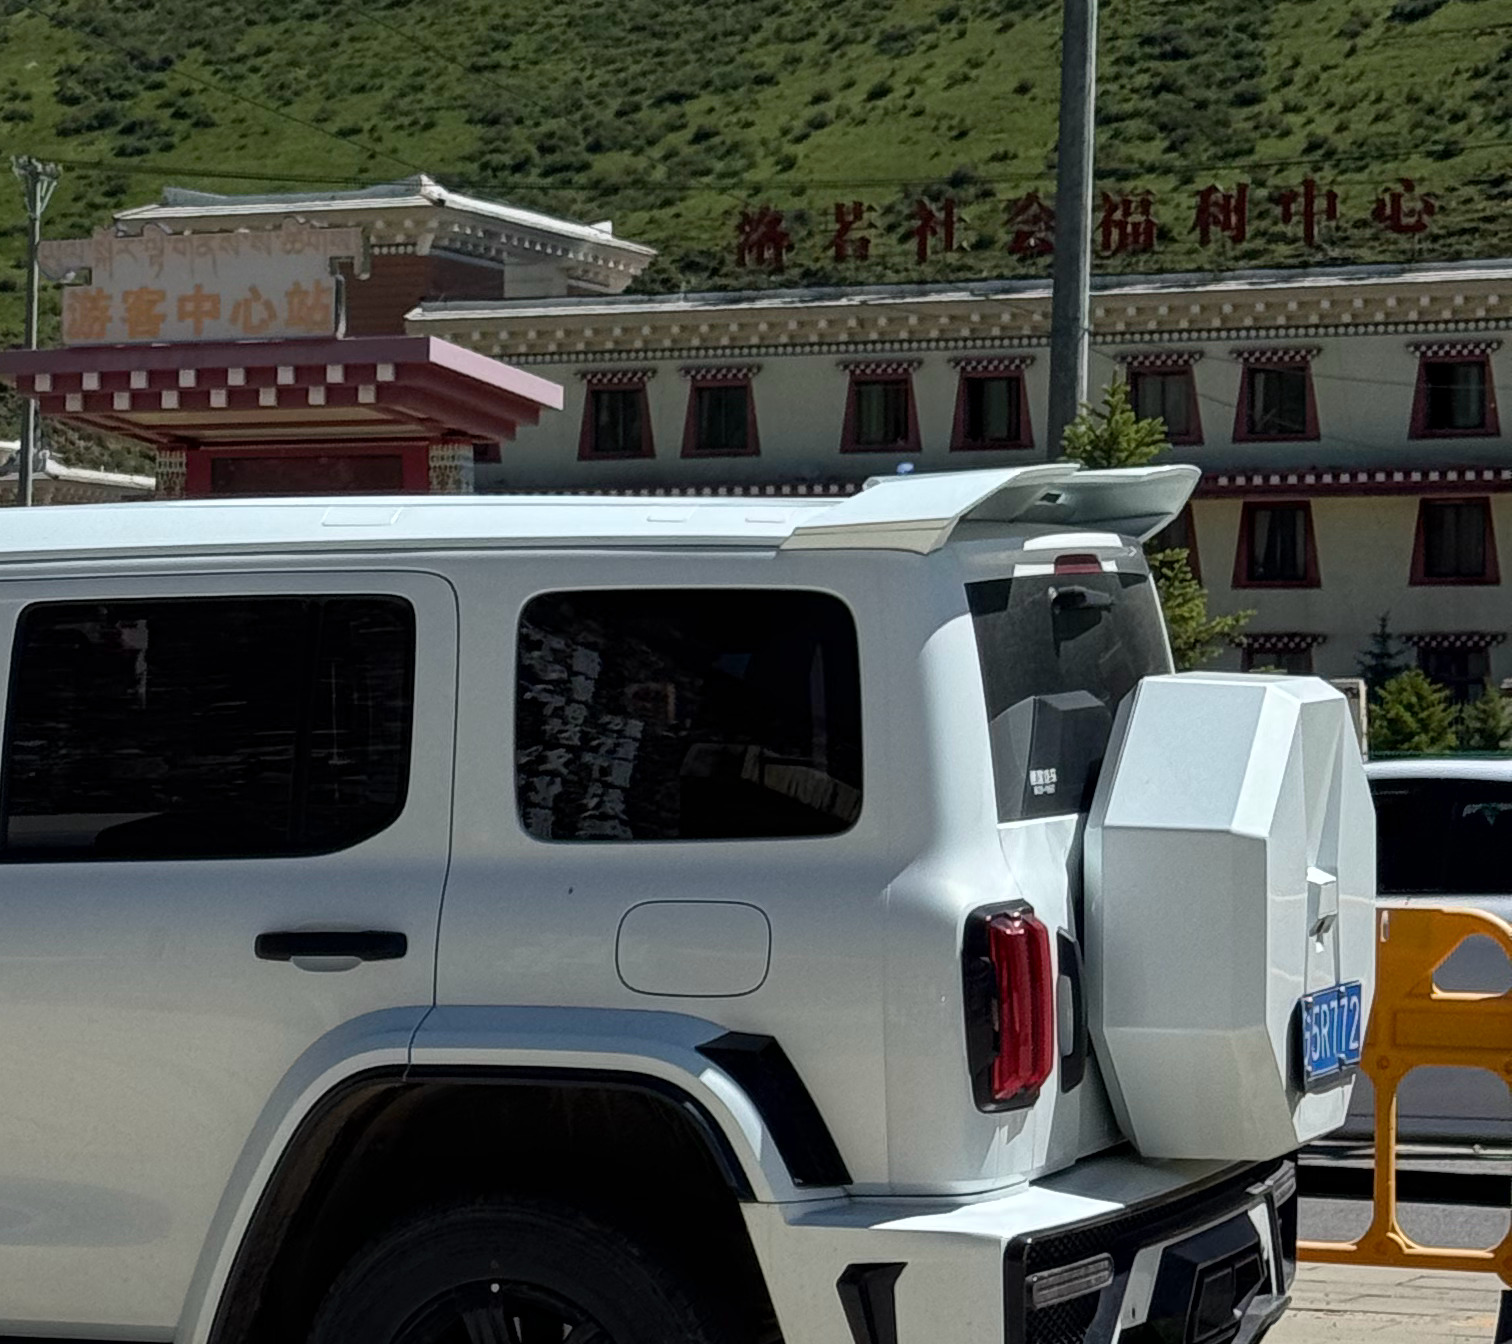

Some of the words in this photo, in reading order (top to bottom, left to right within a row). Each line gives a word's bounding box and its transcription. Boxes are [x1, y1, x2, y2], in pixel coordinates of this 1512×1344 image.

[67, 279, 330, 339] 游客中心站
